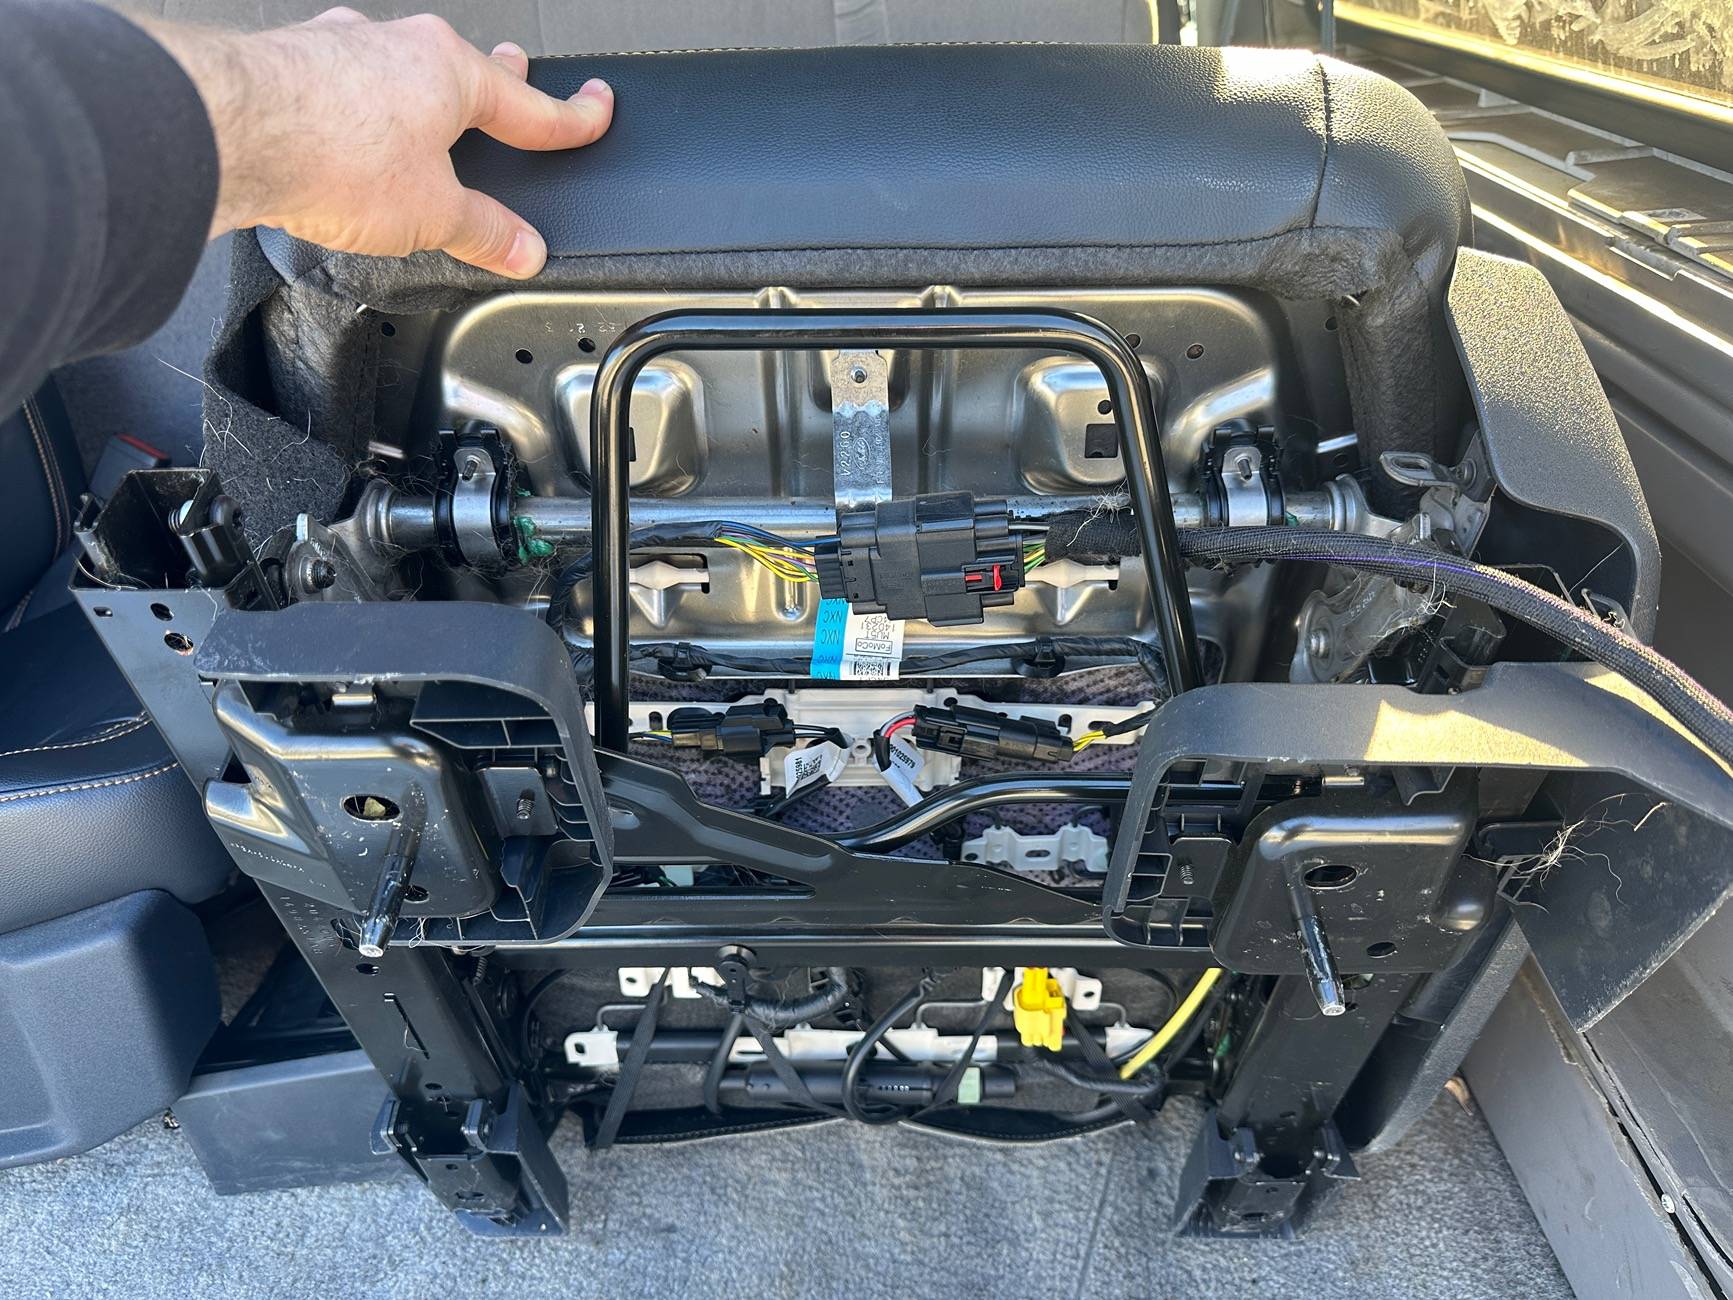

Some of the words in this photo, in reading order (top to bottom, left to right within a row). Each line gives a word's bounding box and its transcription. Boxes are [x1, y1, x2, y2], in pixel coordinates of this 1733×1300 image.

[840, 431, 851, 476] V2260
[823, 610, 842, 624] NXC
[821, 629, 839, 644] NXC
[857, 641, 891, 652] FoMoCo
